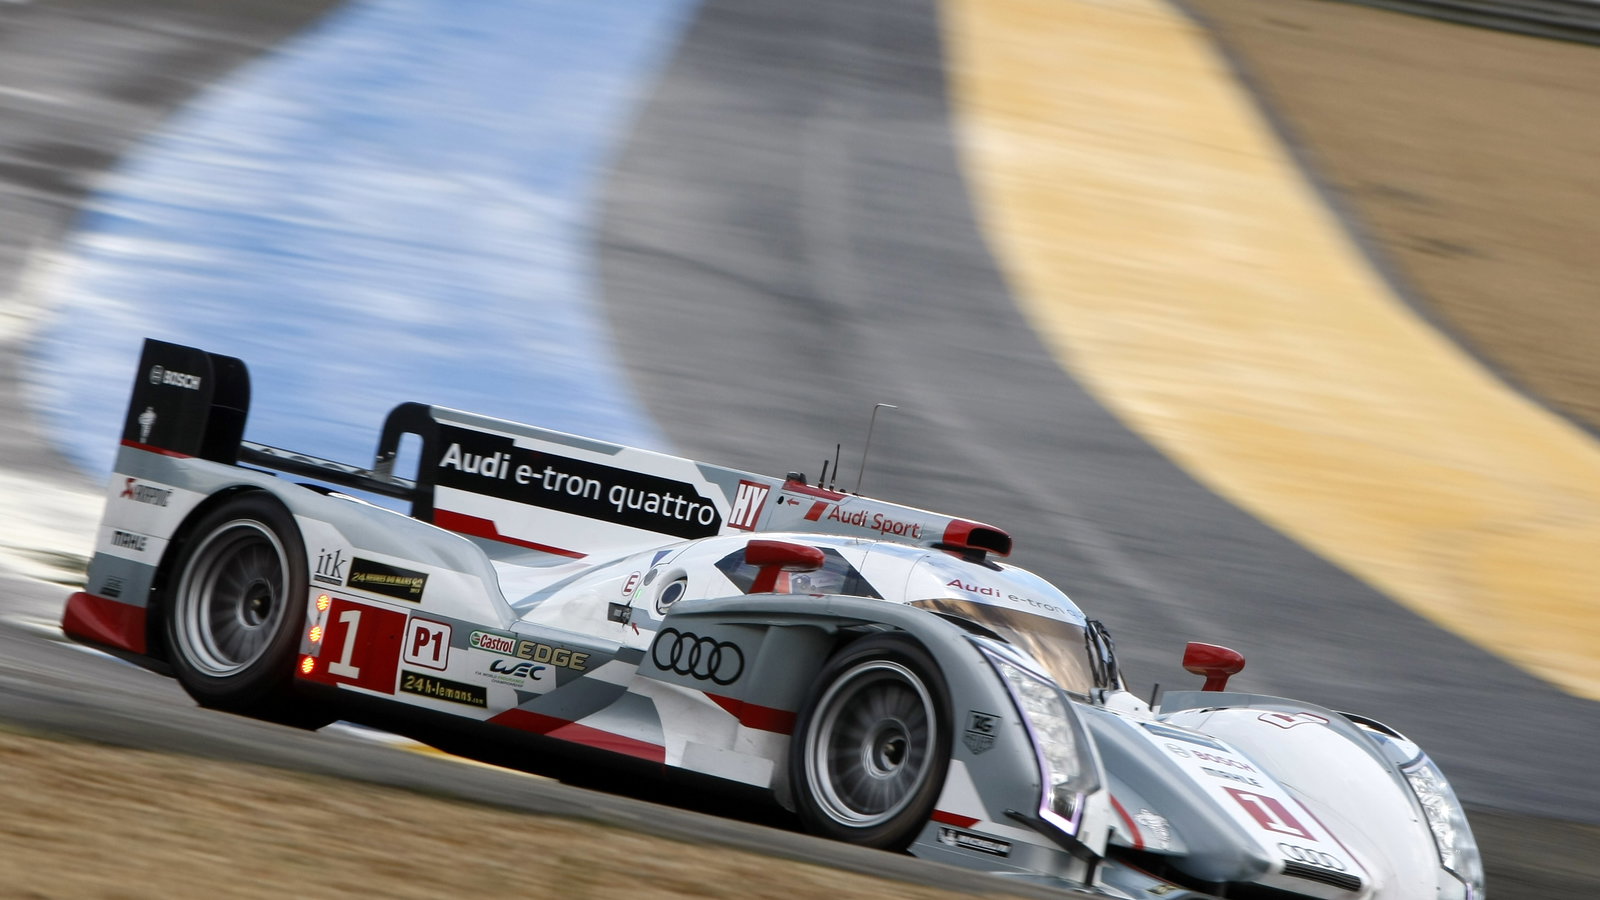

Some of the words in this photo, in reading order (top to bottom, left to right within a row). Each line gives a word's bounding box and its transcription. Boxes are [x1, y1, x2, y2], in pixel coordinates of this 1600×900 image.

[439, 443, 511, 480] Audi
[515, 464, 601, 500] e-tron
[608, 485, 715, 526] quattro
[729, 484, 769, 527] HY
[827, 505, 869, 527] Audi
[871, 513, 920, 539] Sport
[316, 548, 346, 579] itk
[351, 572, 366, 582] 24
[623, 575, 639, 592] E
[946, 579, 1001, 598] Audi
[1007, 594, 1066, 615] e-tron
[327, 610, 362, 680] 1
[412, 626, 443, 661] P1
[480, 634, 513, 654] Castrol
[516, 640, 591, 671] EDGE
[490, 660, 546, 680] WEC
[1190, 749, 1257, 774] BOSCH
[1236, 793, 1304, 837] 1
